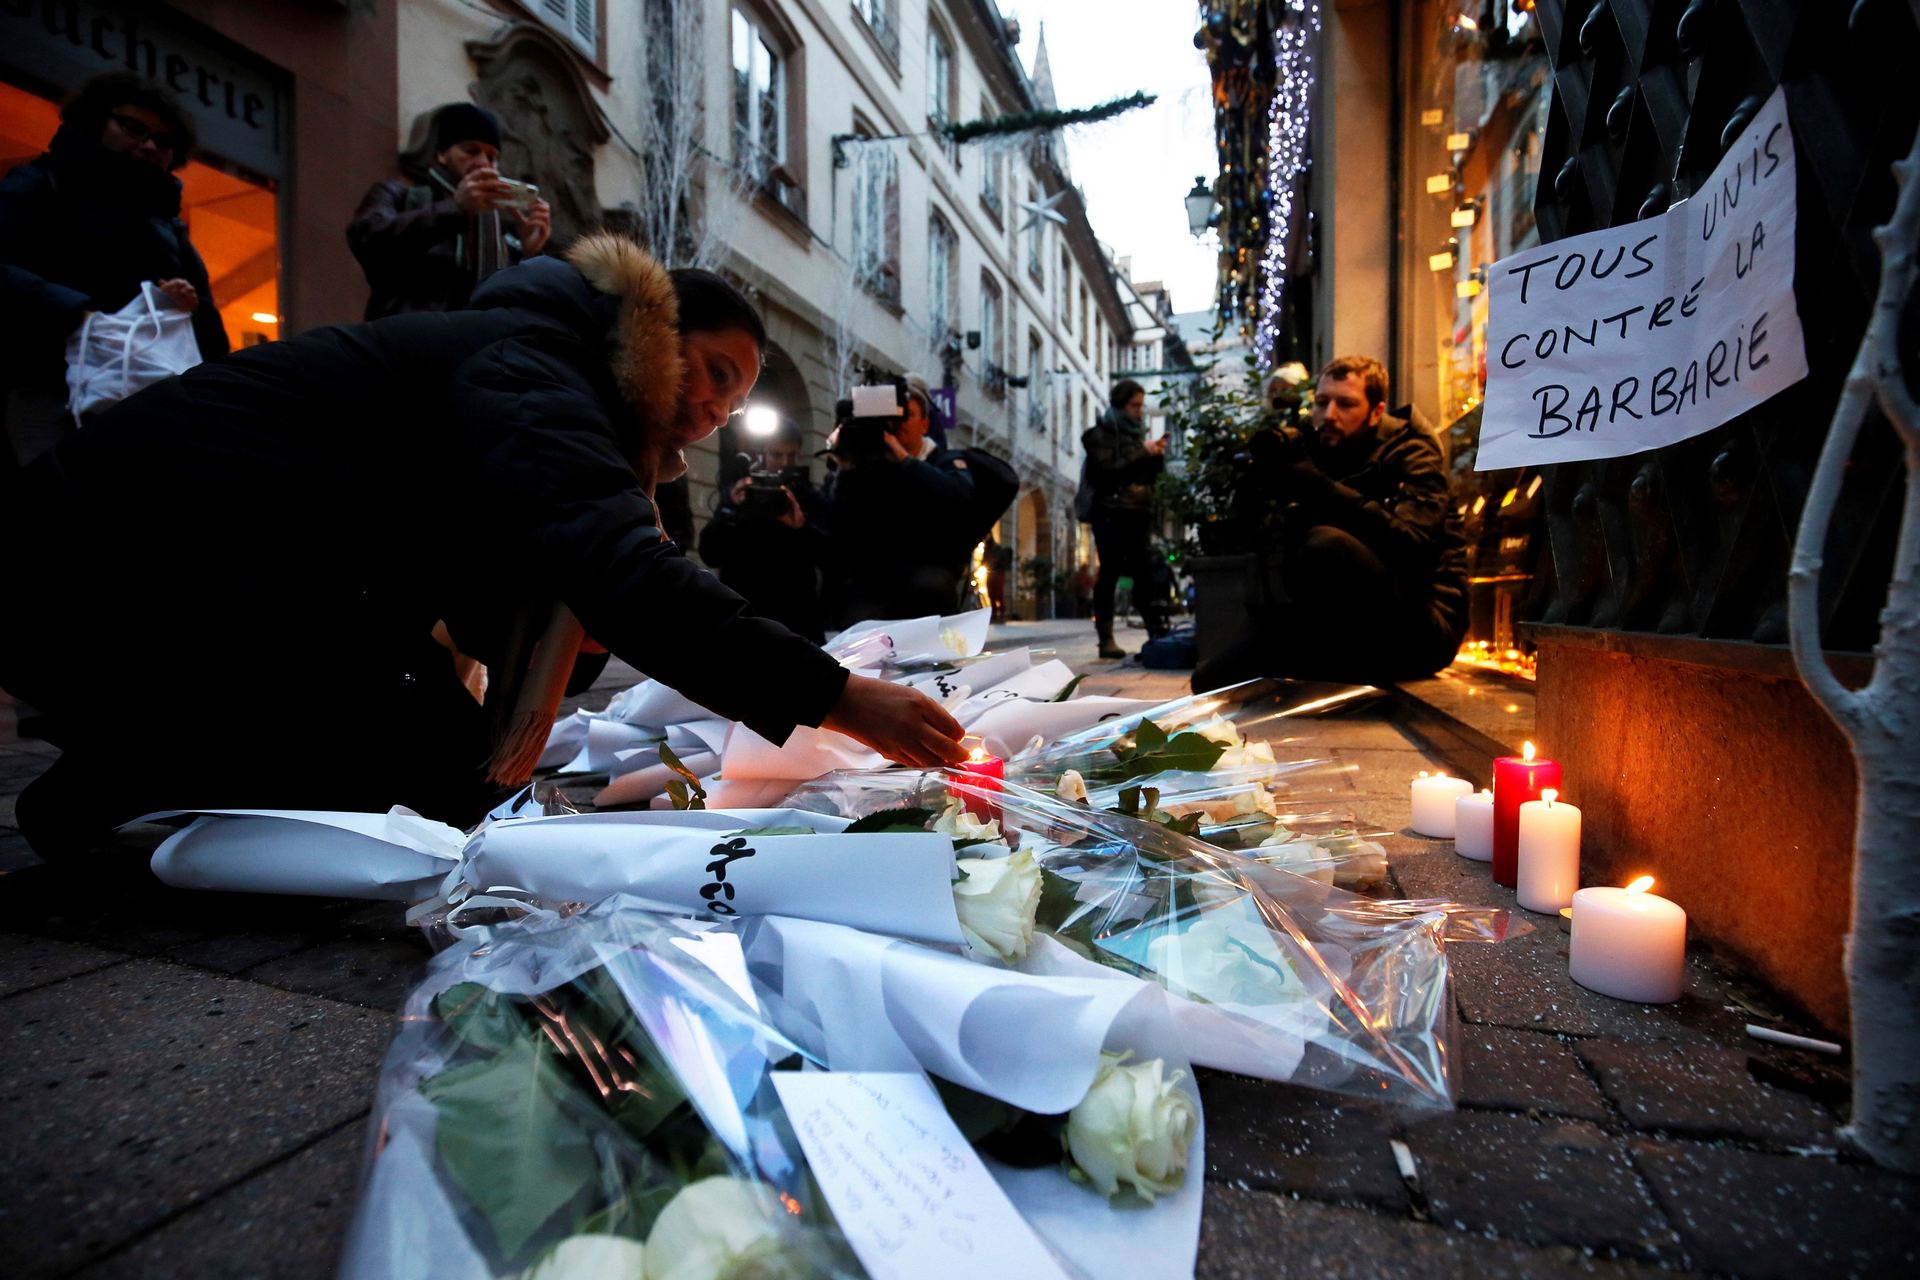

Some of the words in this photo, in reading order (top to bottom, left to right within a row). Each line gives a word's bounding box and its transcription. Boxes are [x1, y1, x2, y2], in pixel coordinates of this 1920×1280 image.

[1500, 277, 1705, 368] CONTRE
[1735, 220, 1766, 279] LA
[1509, 235, 1658, 303] TOUS
